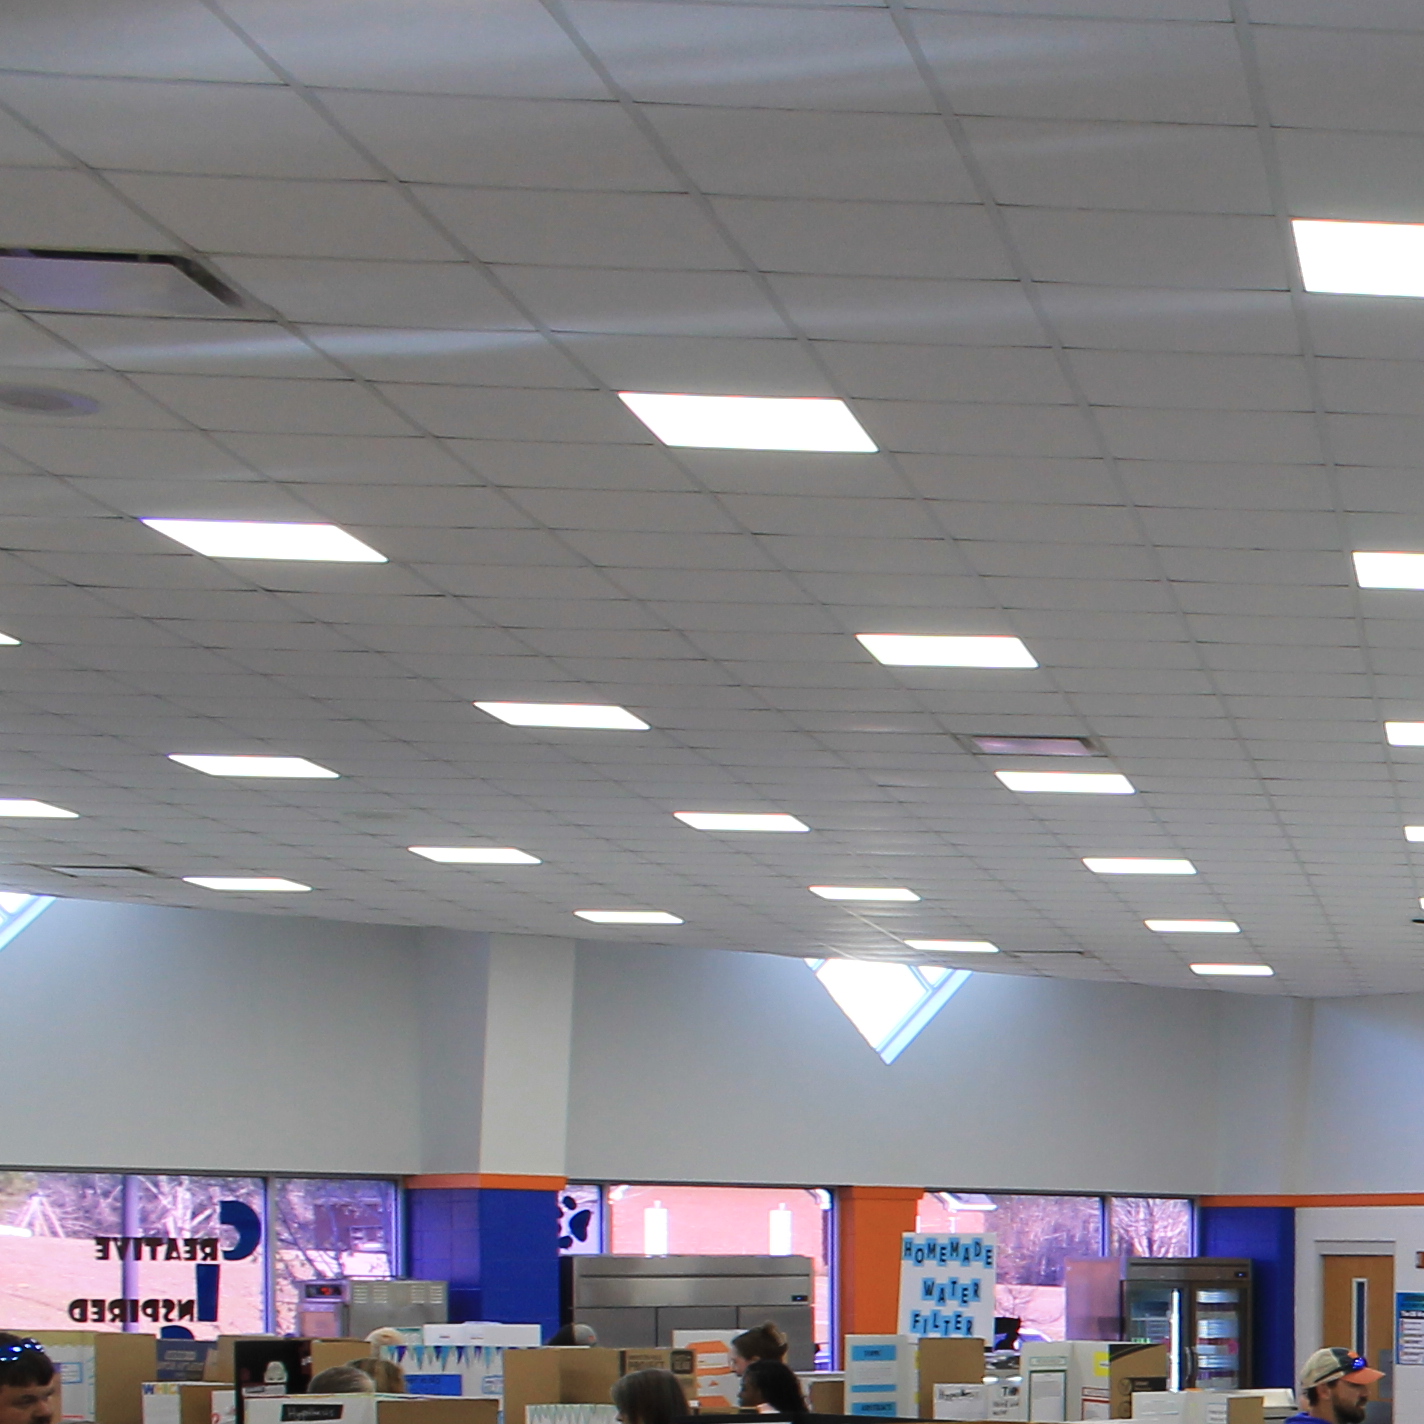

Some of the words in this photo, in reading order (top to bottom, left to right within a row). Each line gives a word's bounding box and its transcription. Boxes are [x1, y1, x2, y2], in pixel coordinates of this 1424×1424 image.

[904, 1240, 993, 1267] HOMEMADE
[922, 1279, 981, 1304] WATER
[911, 1311, 973, 1337] FILTER
